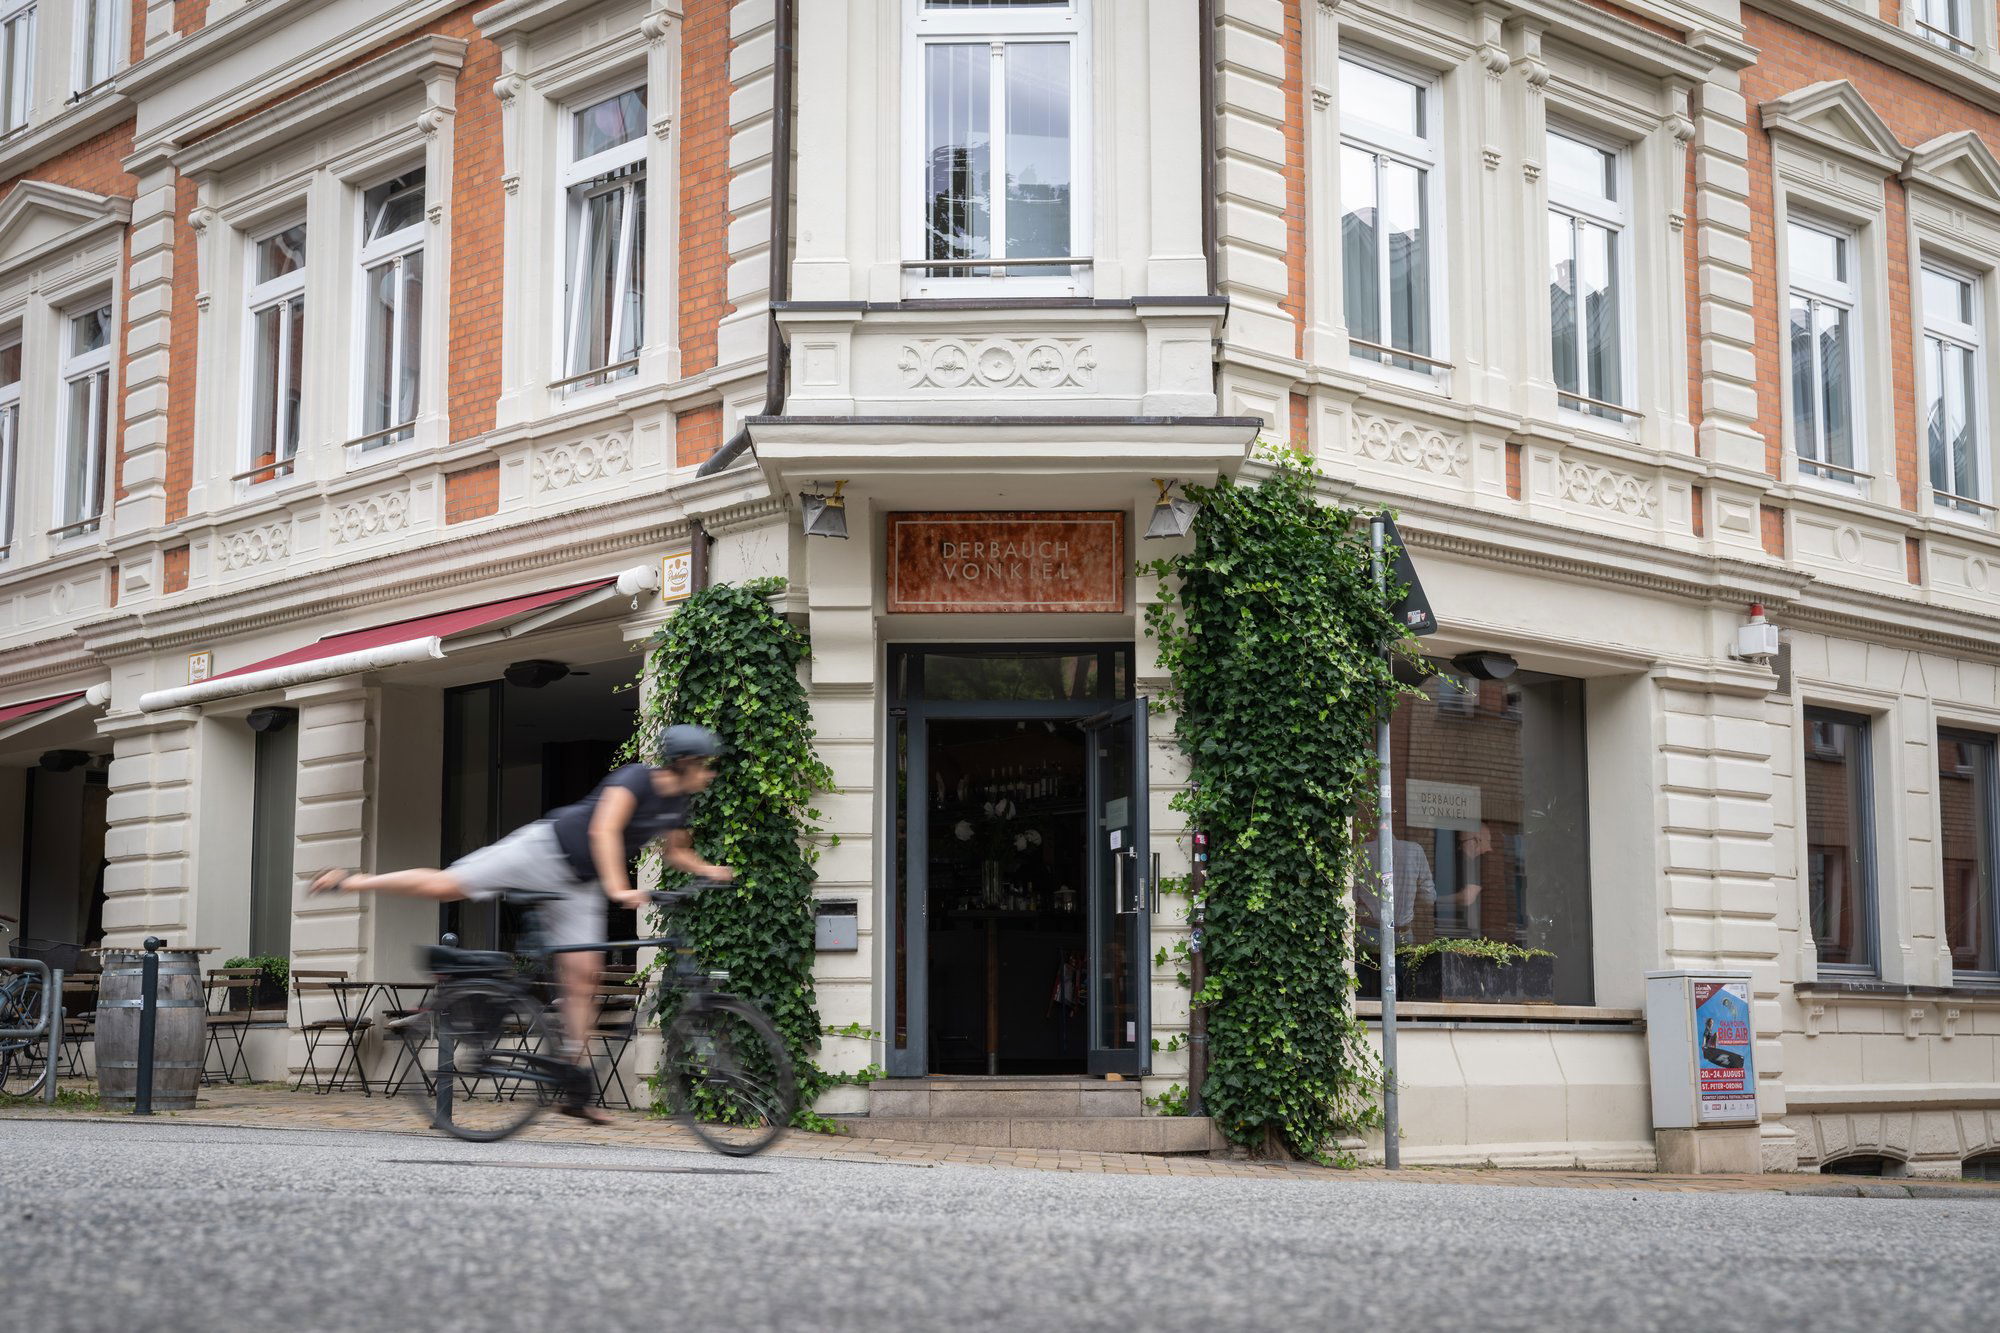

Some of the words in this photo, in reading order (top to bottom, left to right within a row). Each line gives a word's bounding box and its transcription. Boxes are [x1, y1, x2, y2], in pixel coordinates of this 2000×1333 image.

[943, 541, 1069, 559] DERBAUCH
[943, 563, 1069, 580] VONKIEL
[1421, 793, 1467, 807] DERBAUCH
[1421, 806, 1467, 819] VONKIEL
[1717, 1027, 1733, 1040] BIG
[1735, 1027, 1748, 1041] AIR
[1701, 1070, 1722, 1078] 20.-24.
[1723, 1070, 1744, 1078] AUGUST
[1710, 1082, 1742, 1090] PETER-ORDING
